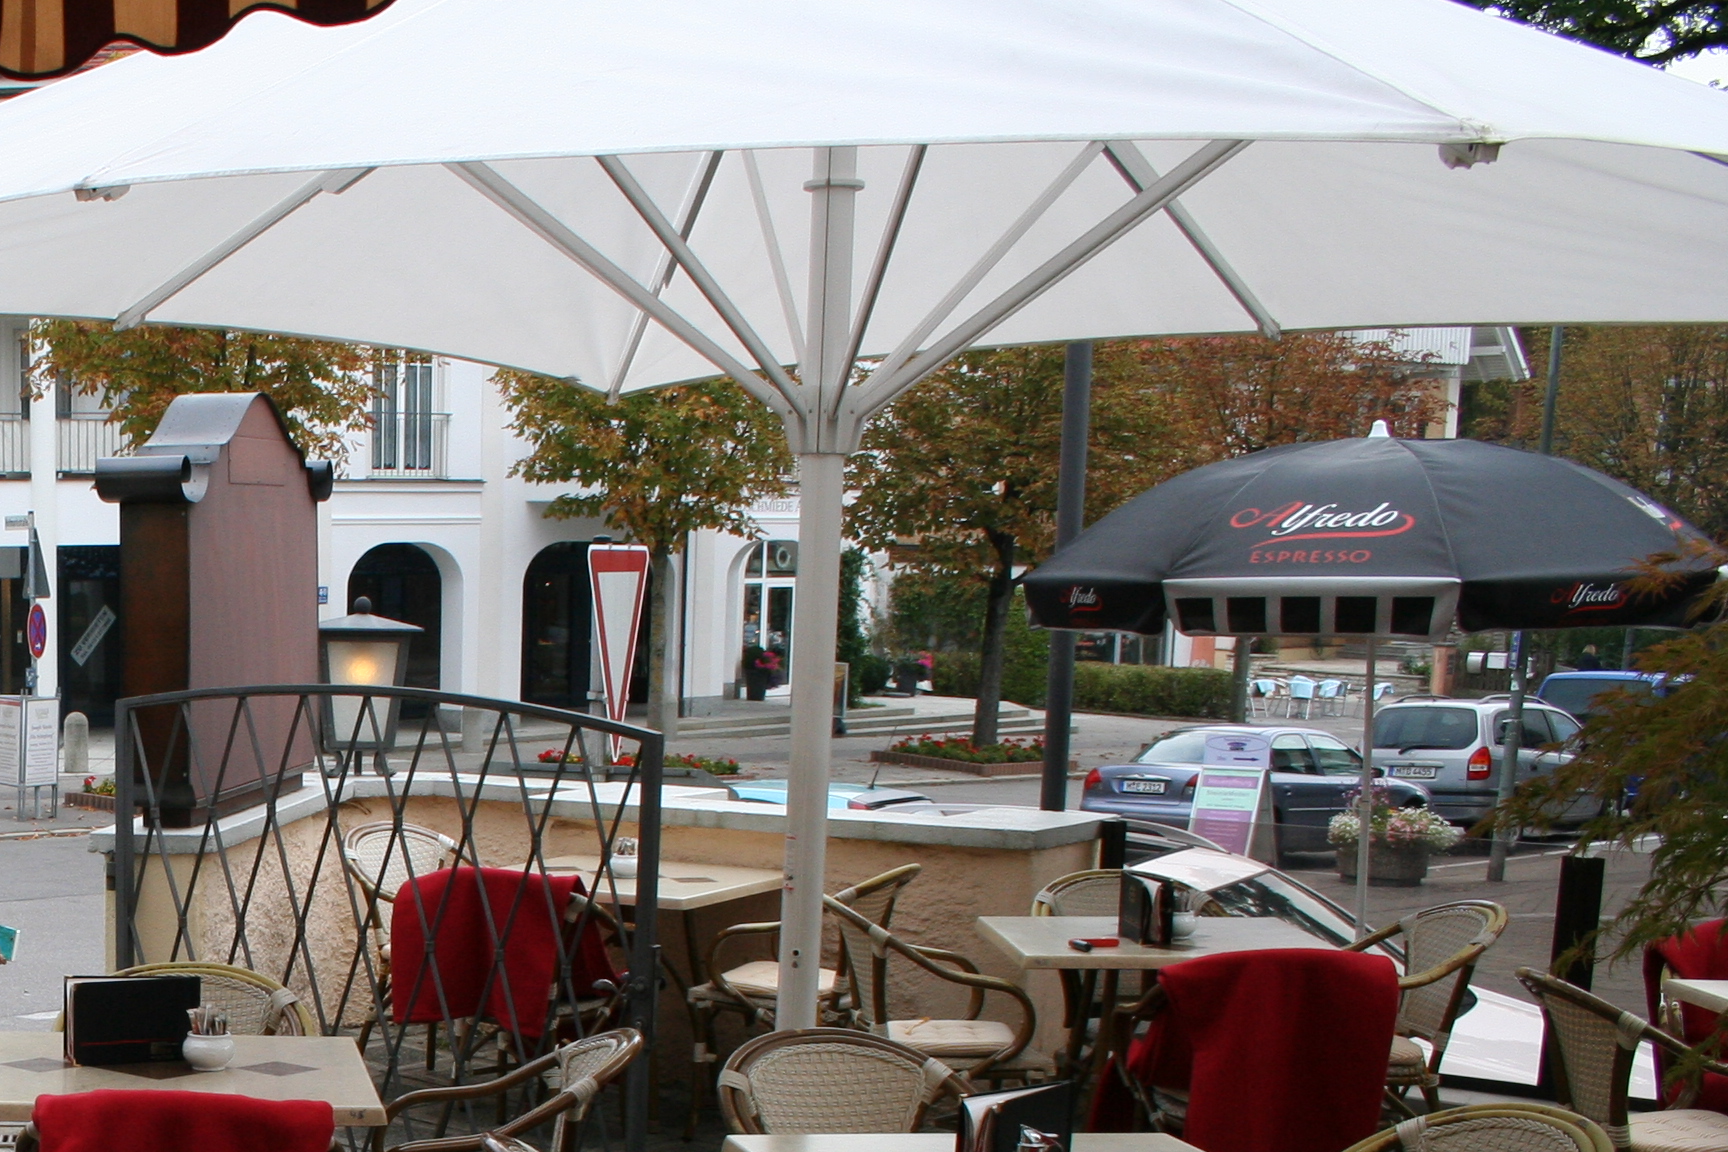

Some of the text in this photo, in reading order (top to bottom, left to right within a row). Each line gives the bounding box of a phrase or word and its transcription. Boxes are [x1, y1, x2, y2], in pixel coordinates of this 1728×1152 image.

[1230, 501, 1400, 536] Alfredo
[1249, 550, 1372, 564] ESPRESSO
[1550, 582, 1619, 609] Alfredo
